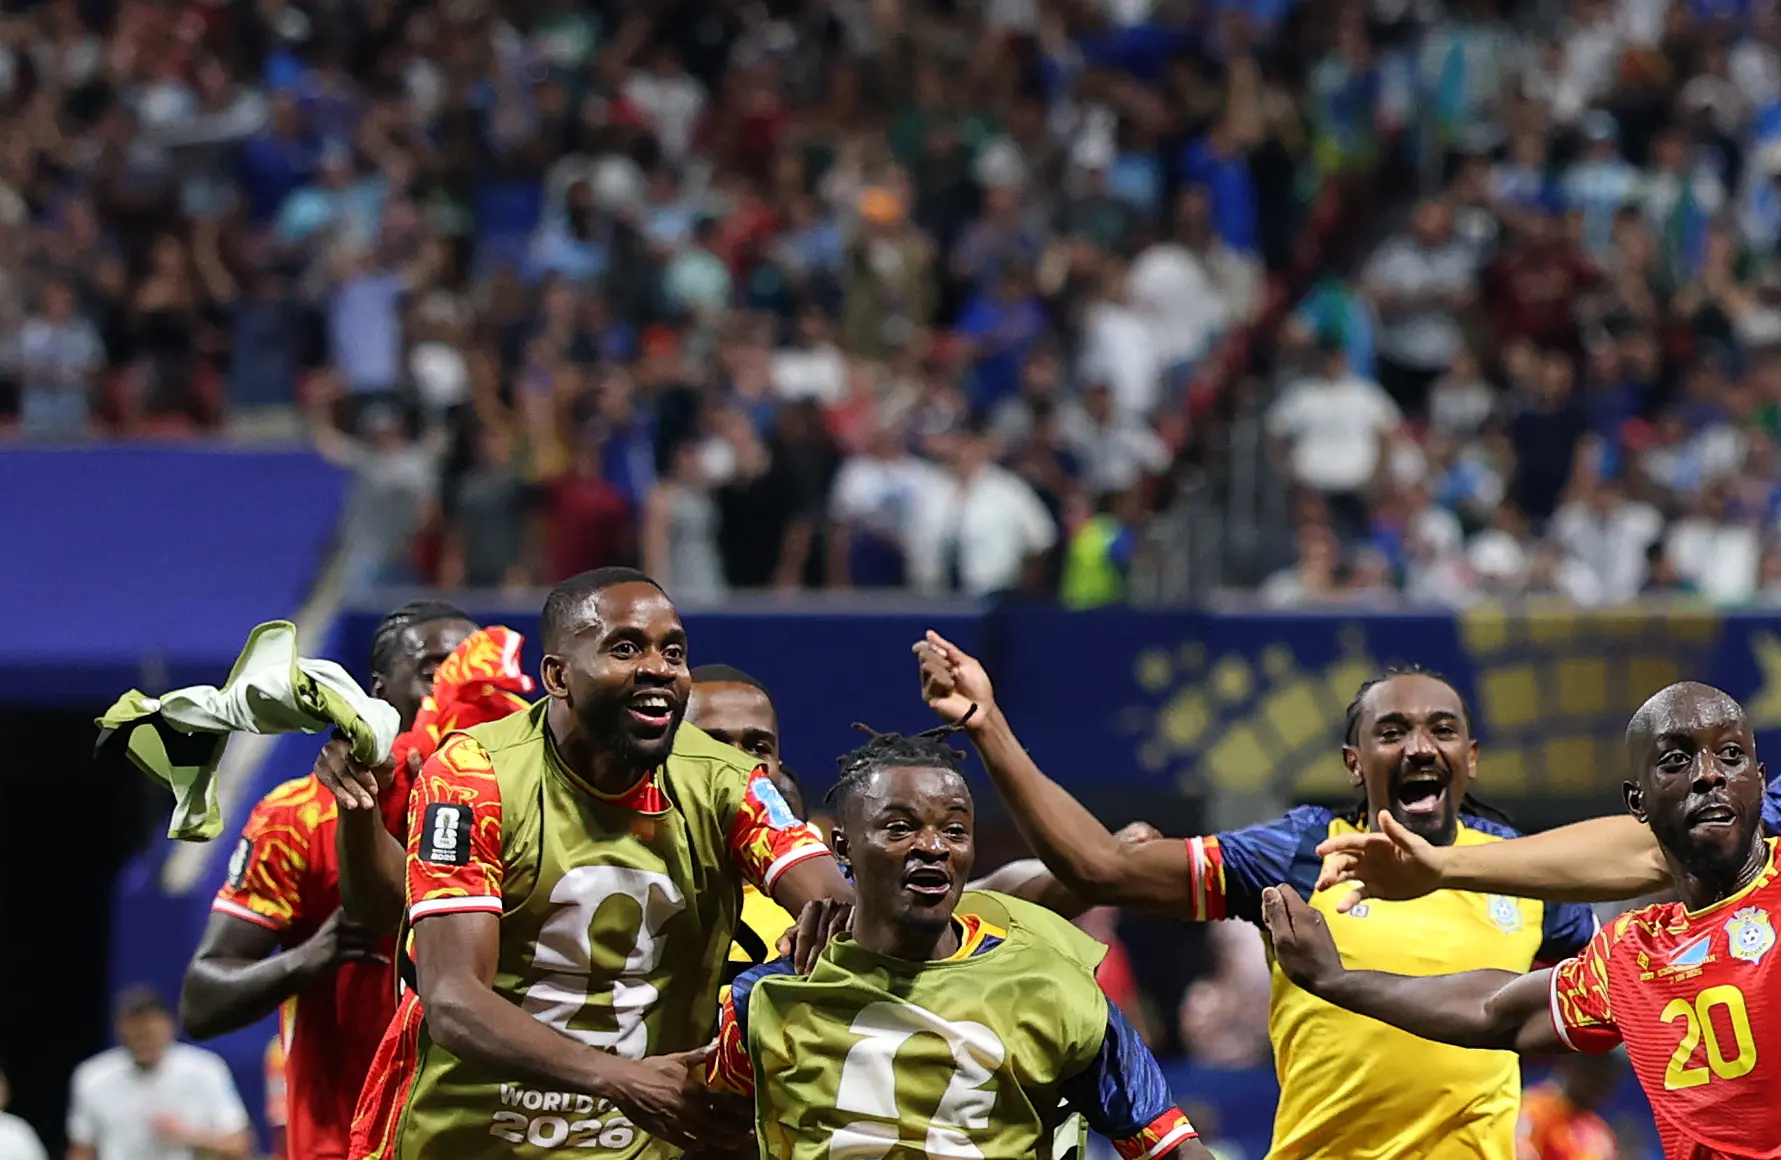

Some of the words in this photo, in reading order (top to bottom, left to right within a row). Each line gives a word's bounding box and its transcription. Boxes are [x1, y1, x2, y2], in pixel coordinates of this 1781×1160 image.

[1660, 984, 1757, 1090] 20
[500, 1083, 594, 1114] WORLD
[489, 1111, 634, 1149] 2026
